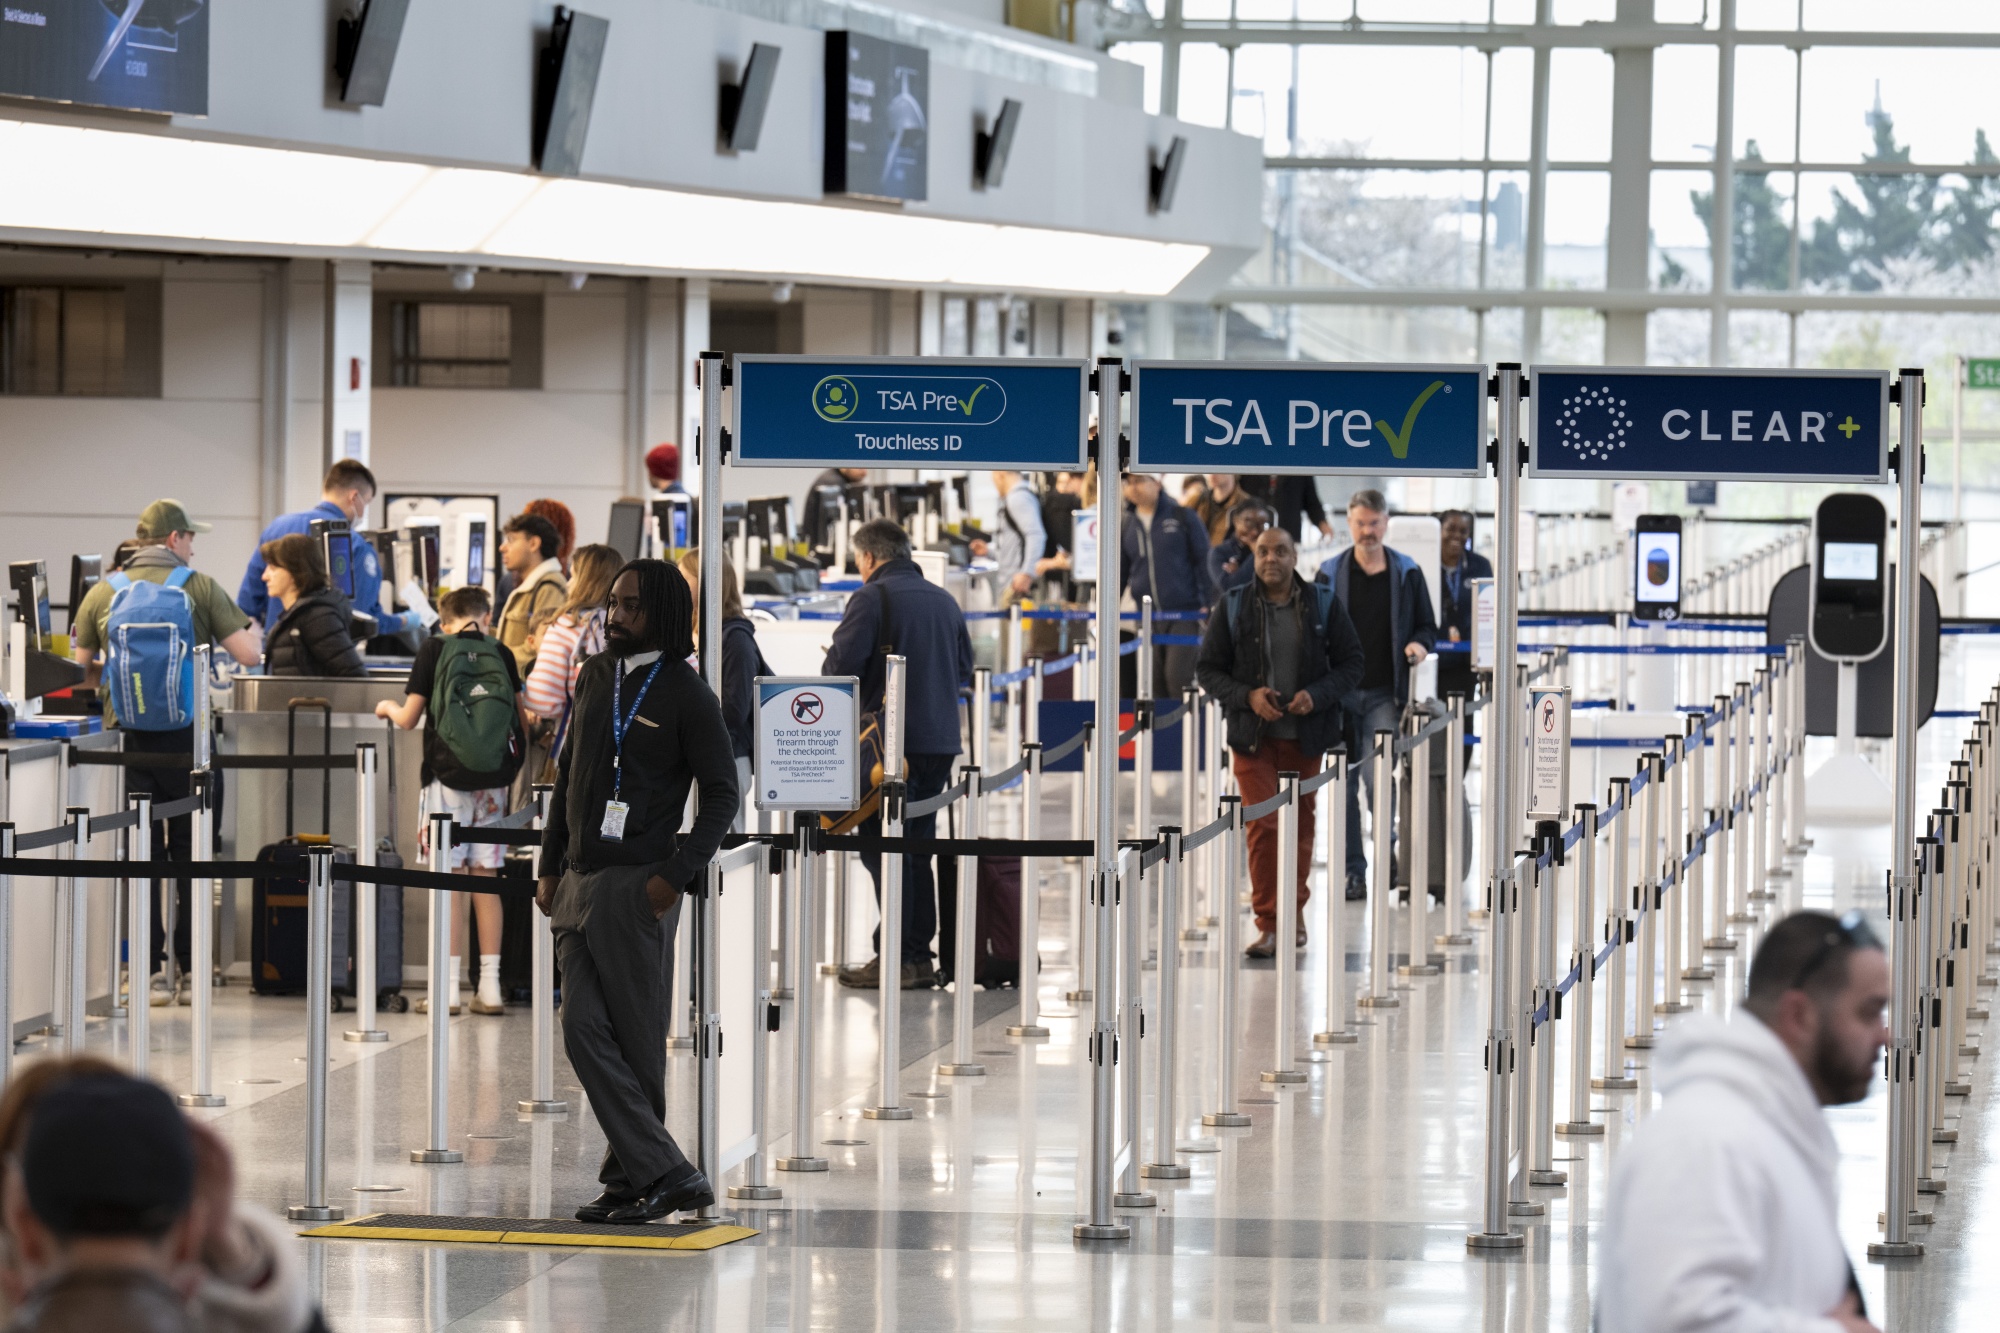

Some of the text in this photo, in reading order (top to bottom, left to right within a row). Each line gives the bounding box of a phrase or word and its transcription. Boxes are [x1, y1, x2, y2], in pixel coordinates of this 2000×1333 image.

[876, 390, 957, 412] TSA Pre
[1172, 398, 1372, 448] TSA Pre
[854, 433, 962, 451] Touchless ID
[773, 729, 842, 738] Do not bring your
[777, 738, 839, 747] firearm through
[778, 748, 837, 757] the checkpoint.
